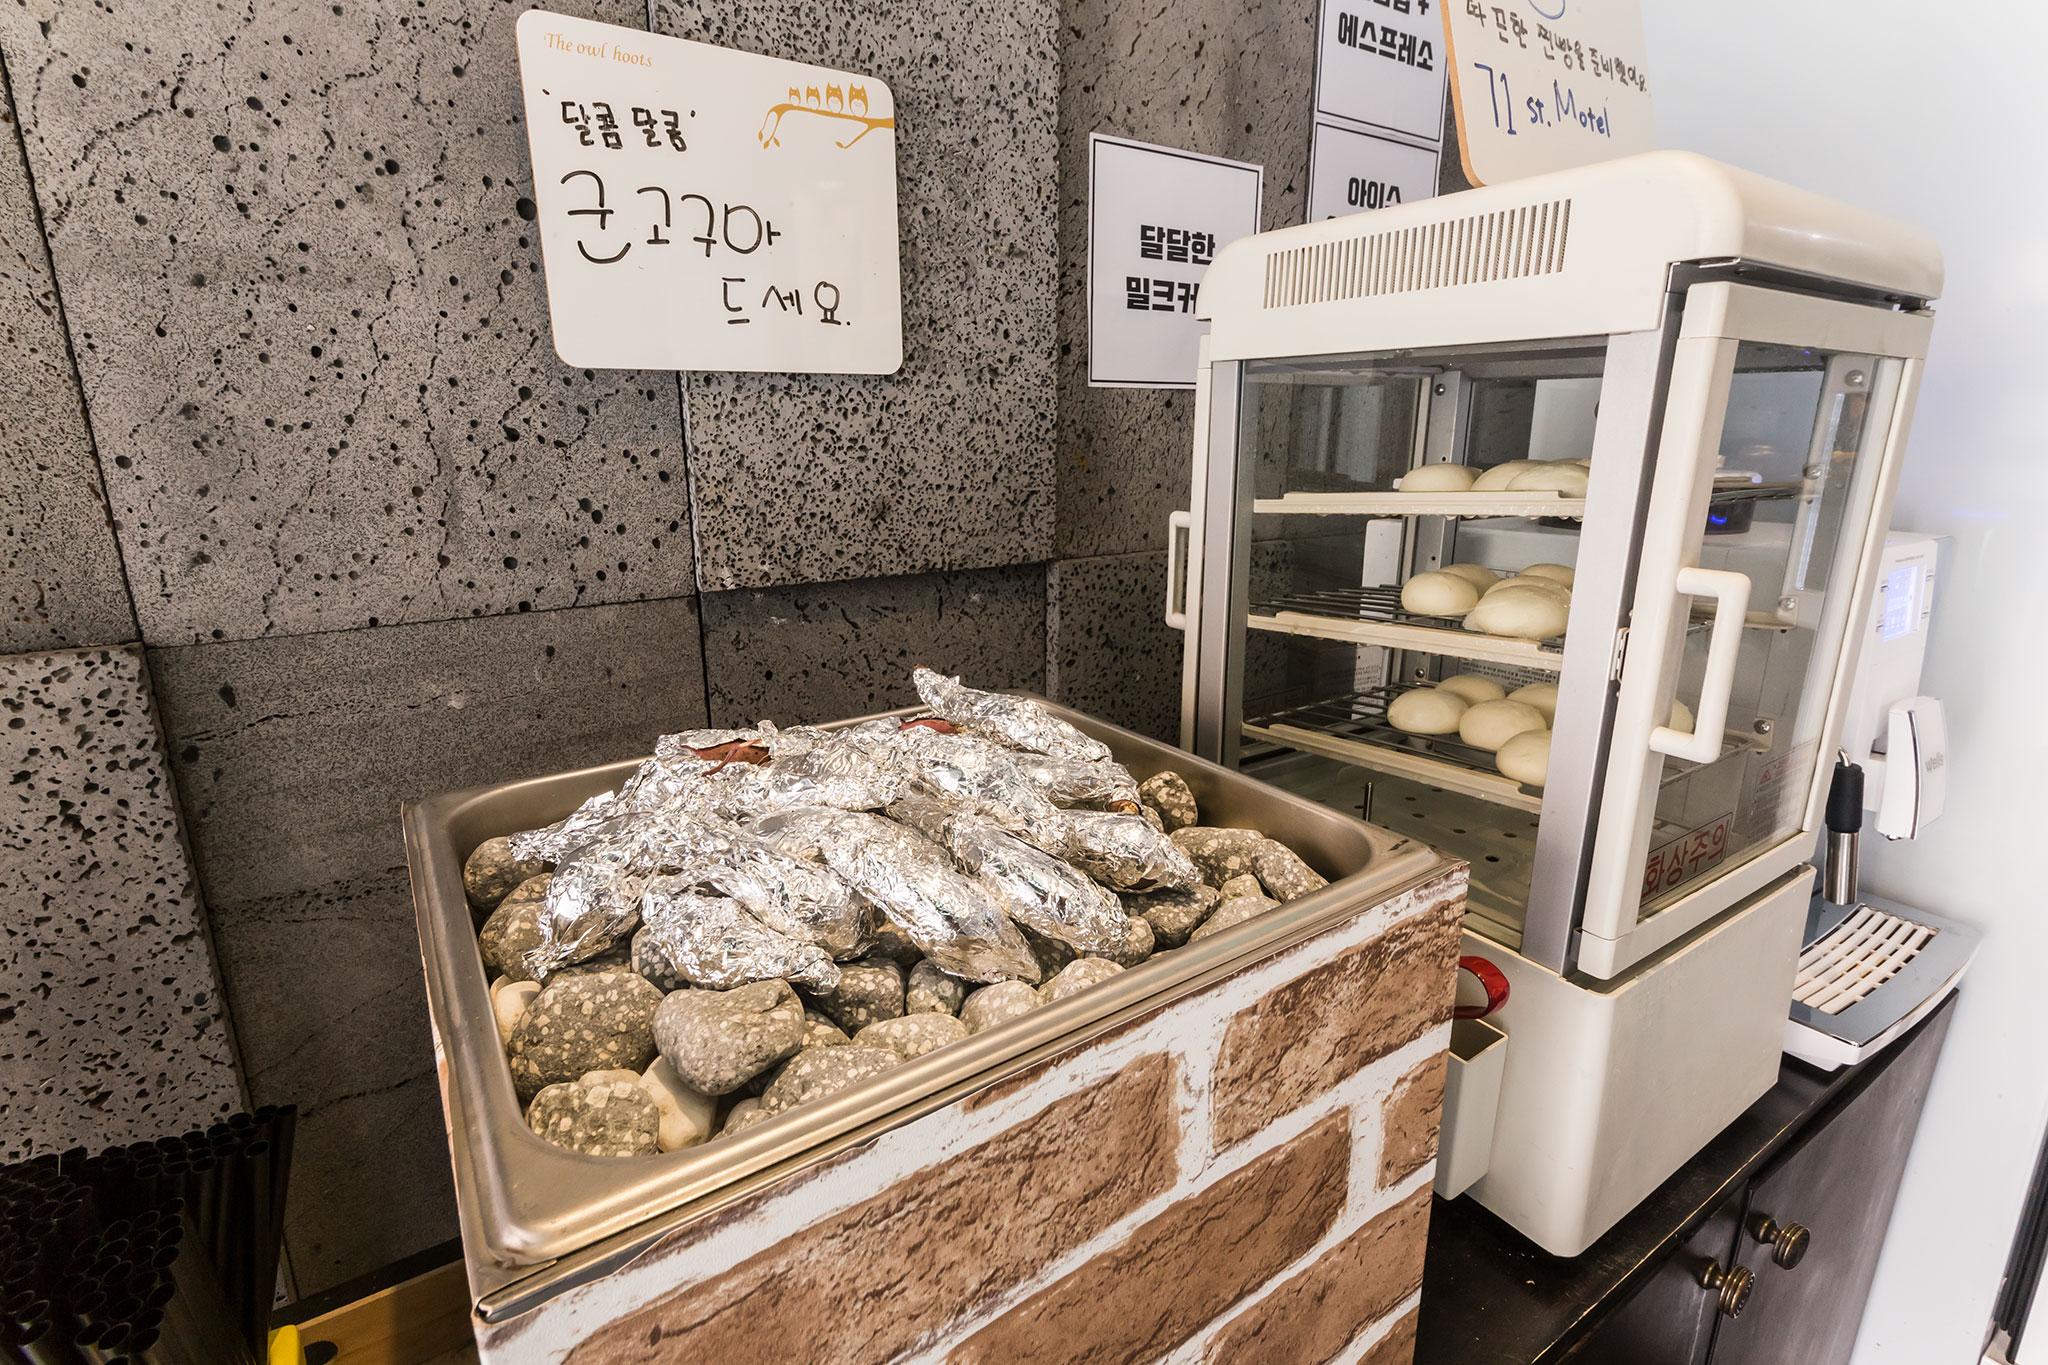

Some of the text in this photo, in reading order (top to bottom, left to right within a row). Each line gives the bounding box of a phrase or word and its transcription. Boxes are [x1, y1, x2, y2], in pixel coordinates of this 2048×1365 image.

[544, 32, 653, 67] The owl hoots
[1337, 11, 1433, 72] 에스프레소
[1474, 62, 1517, 135] 71
[1553, 79, 1611, 138] Motel
[1140, 224, 1216, 266] 달달한
[1640, 819, 1730, 898] 화상주의
